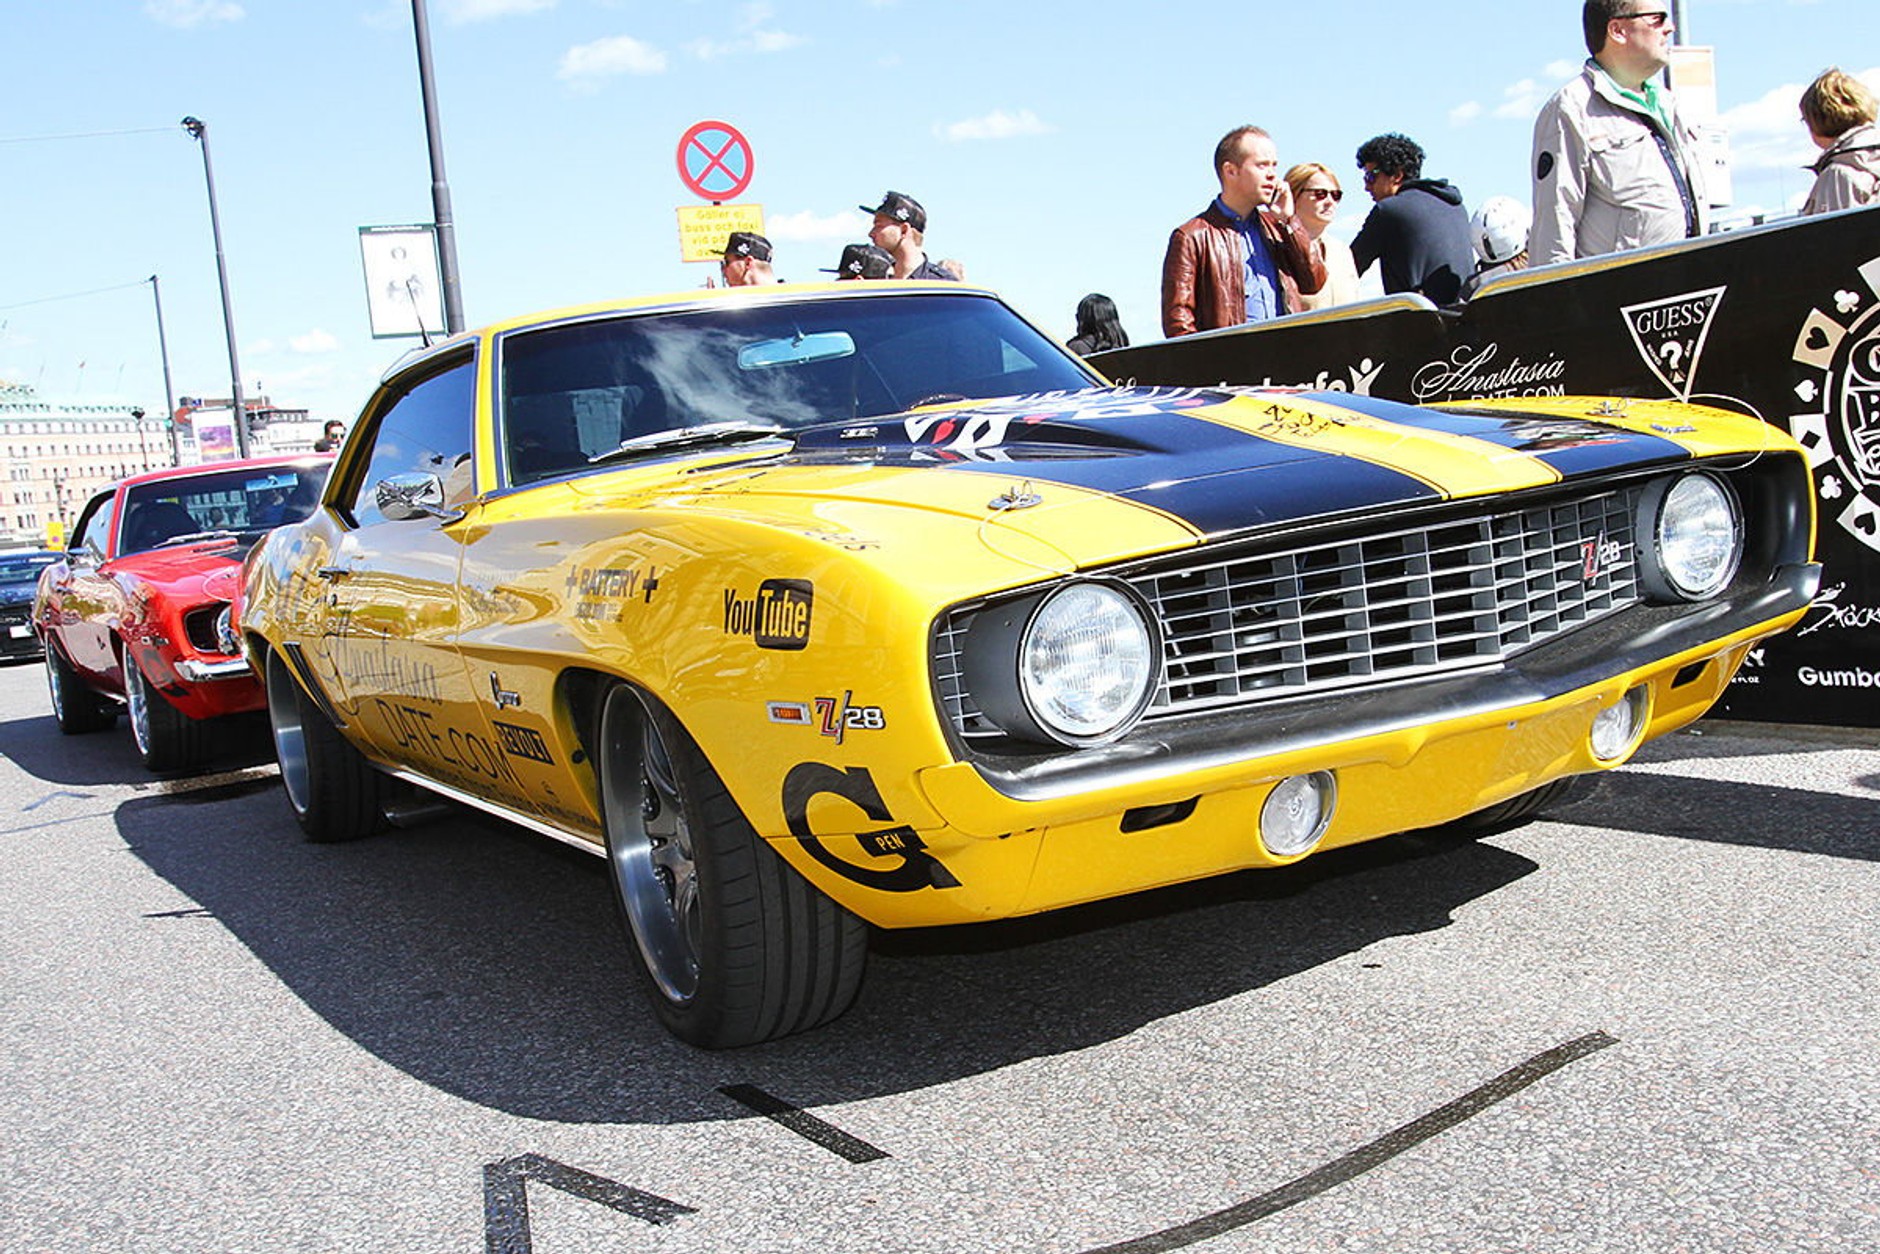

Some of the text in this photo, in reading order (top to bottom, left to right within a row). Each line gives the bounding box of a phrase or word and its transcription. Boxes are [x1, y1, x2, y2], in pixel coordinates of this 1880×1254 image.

[1636, 301, 1706, 334] GUESS
[1411, 342, 1565, 398] Anastasia
[580, 568, 641, 598] BATTERY
[724, 583, 810, 642] YouTube
[375, 698, 525, 790] DATE.COM
[814, 690, 886, 745] Z/28
[875, 833, 906, 851] PEN
